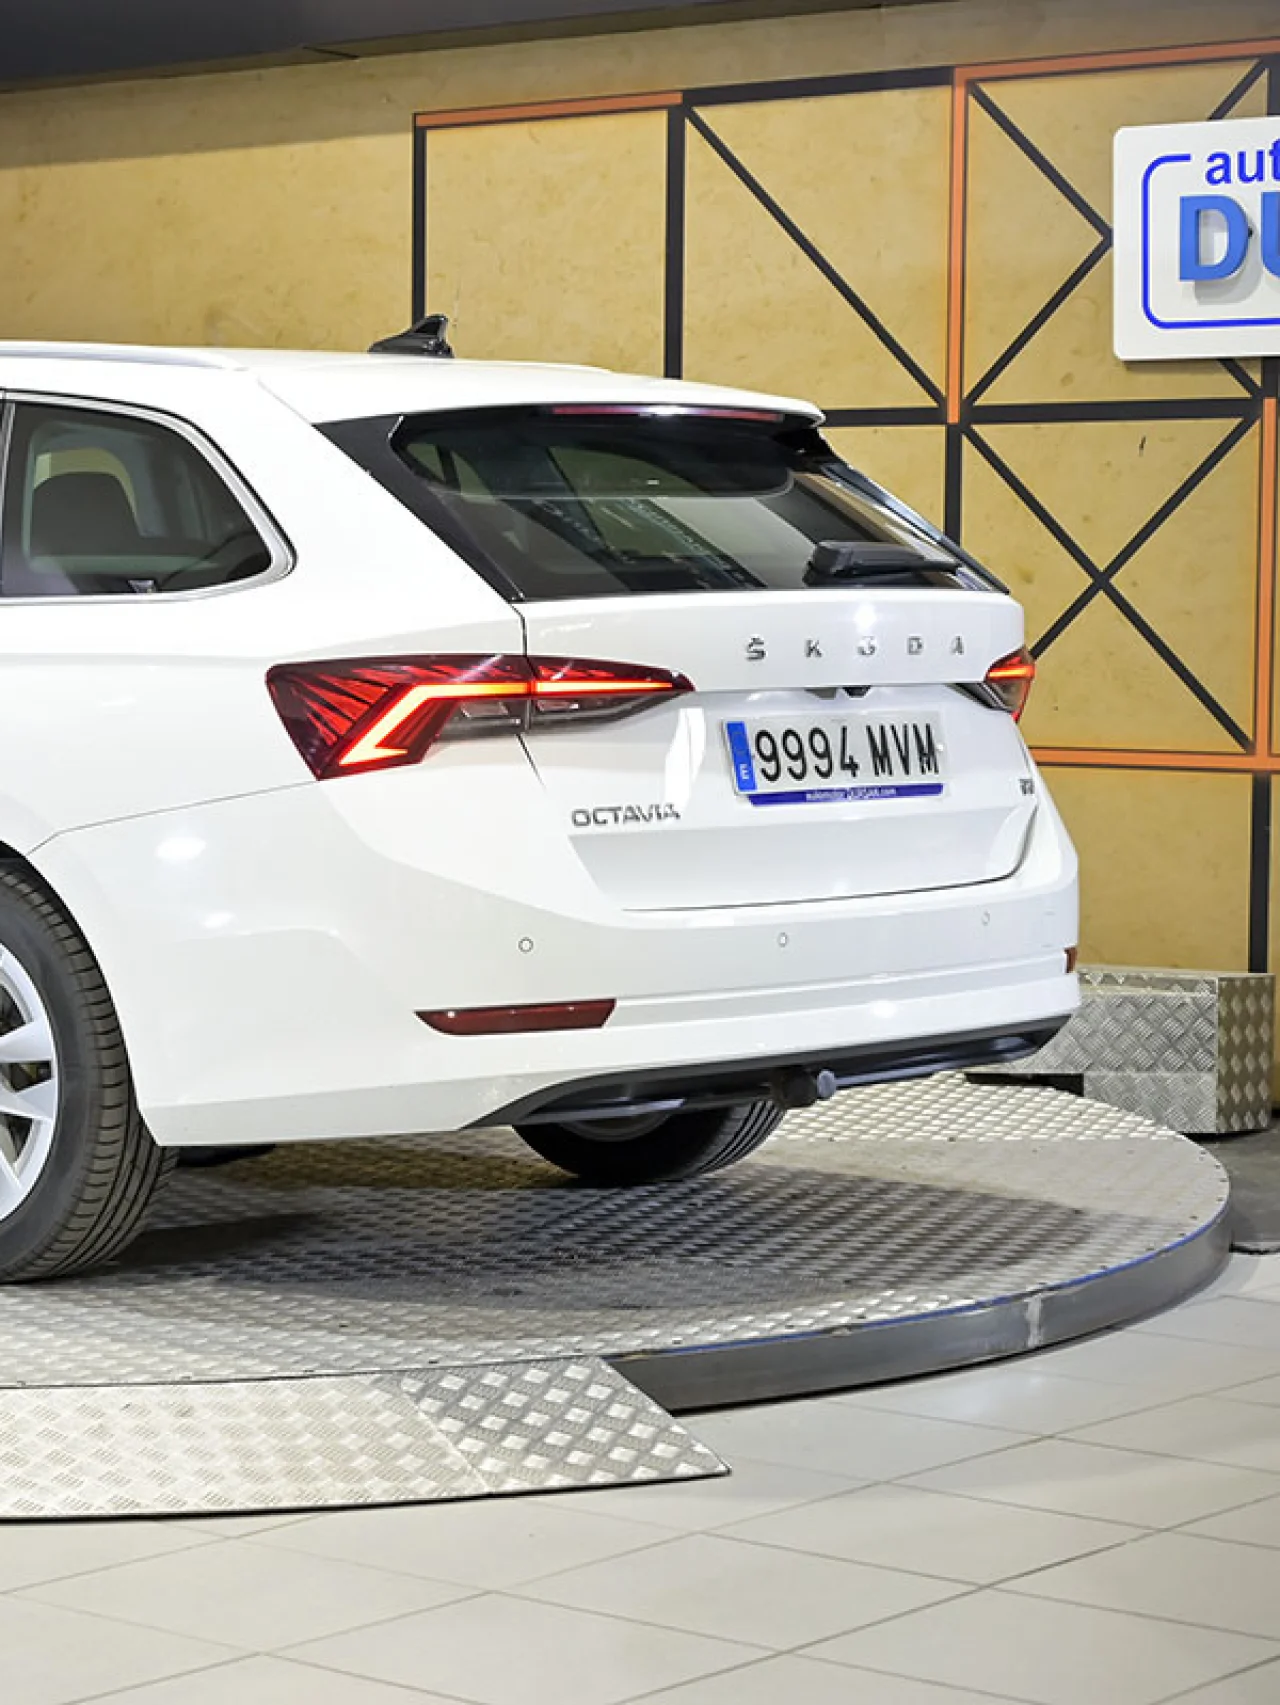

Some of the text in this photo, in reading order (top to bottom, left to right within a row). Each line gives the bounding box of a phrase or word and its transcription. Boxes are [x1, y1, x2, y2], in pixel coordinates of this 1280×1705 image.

[754, 725, 860, 782] 9994
[866, 723, 940, 777] MVM
[571, 803, 682, 827] OCTAVIA
